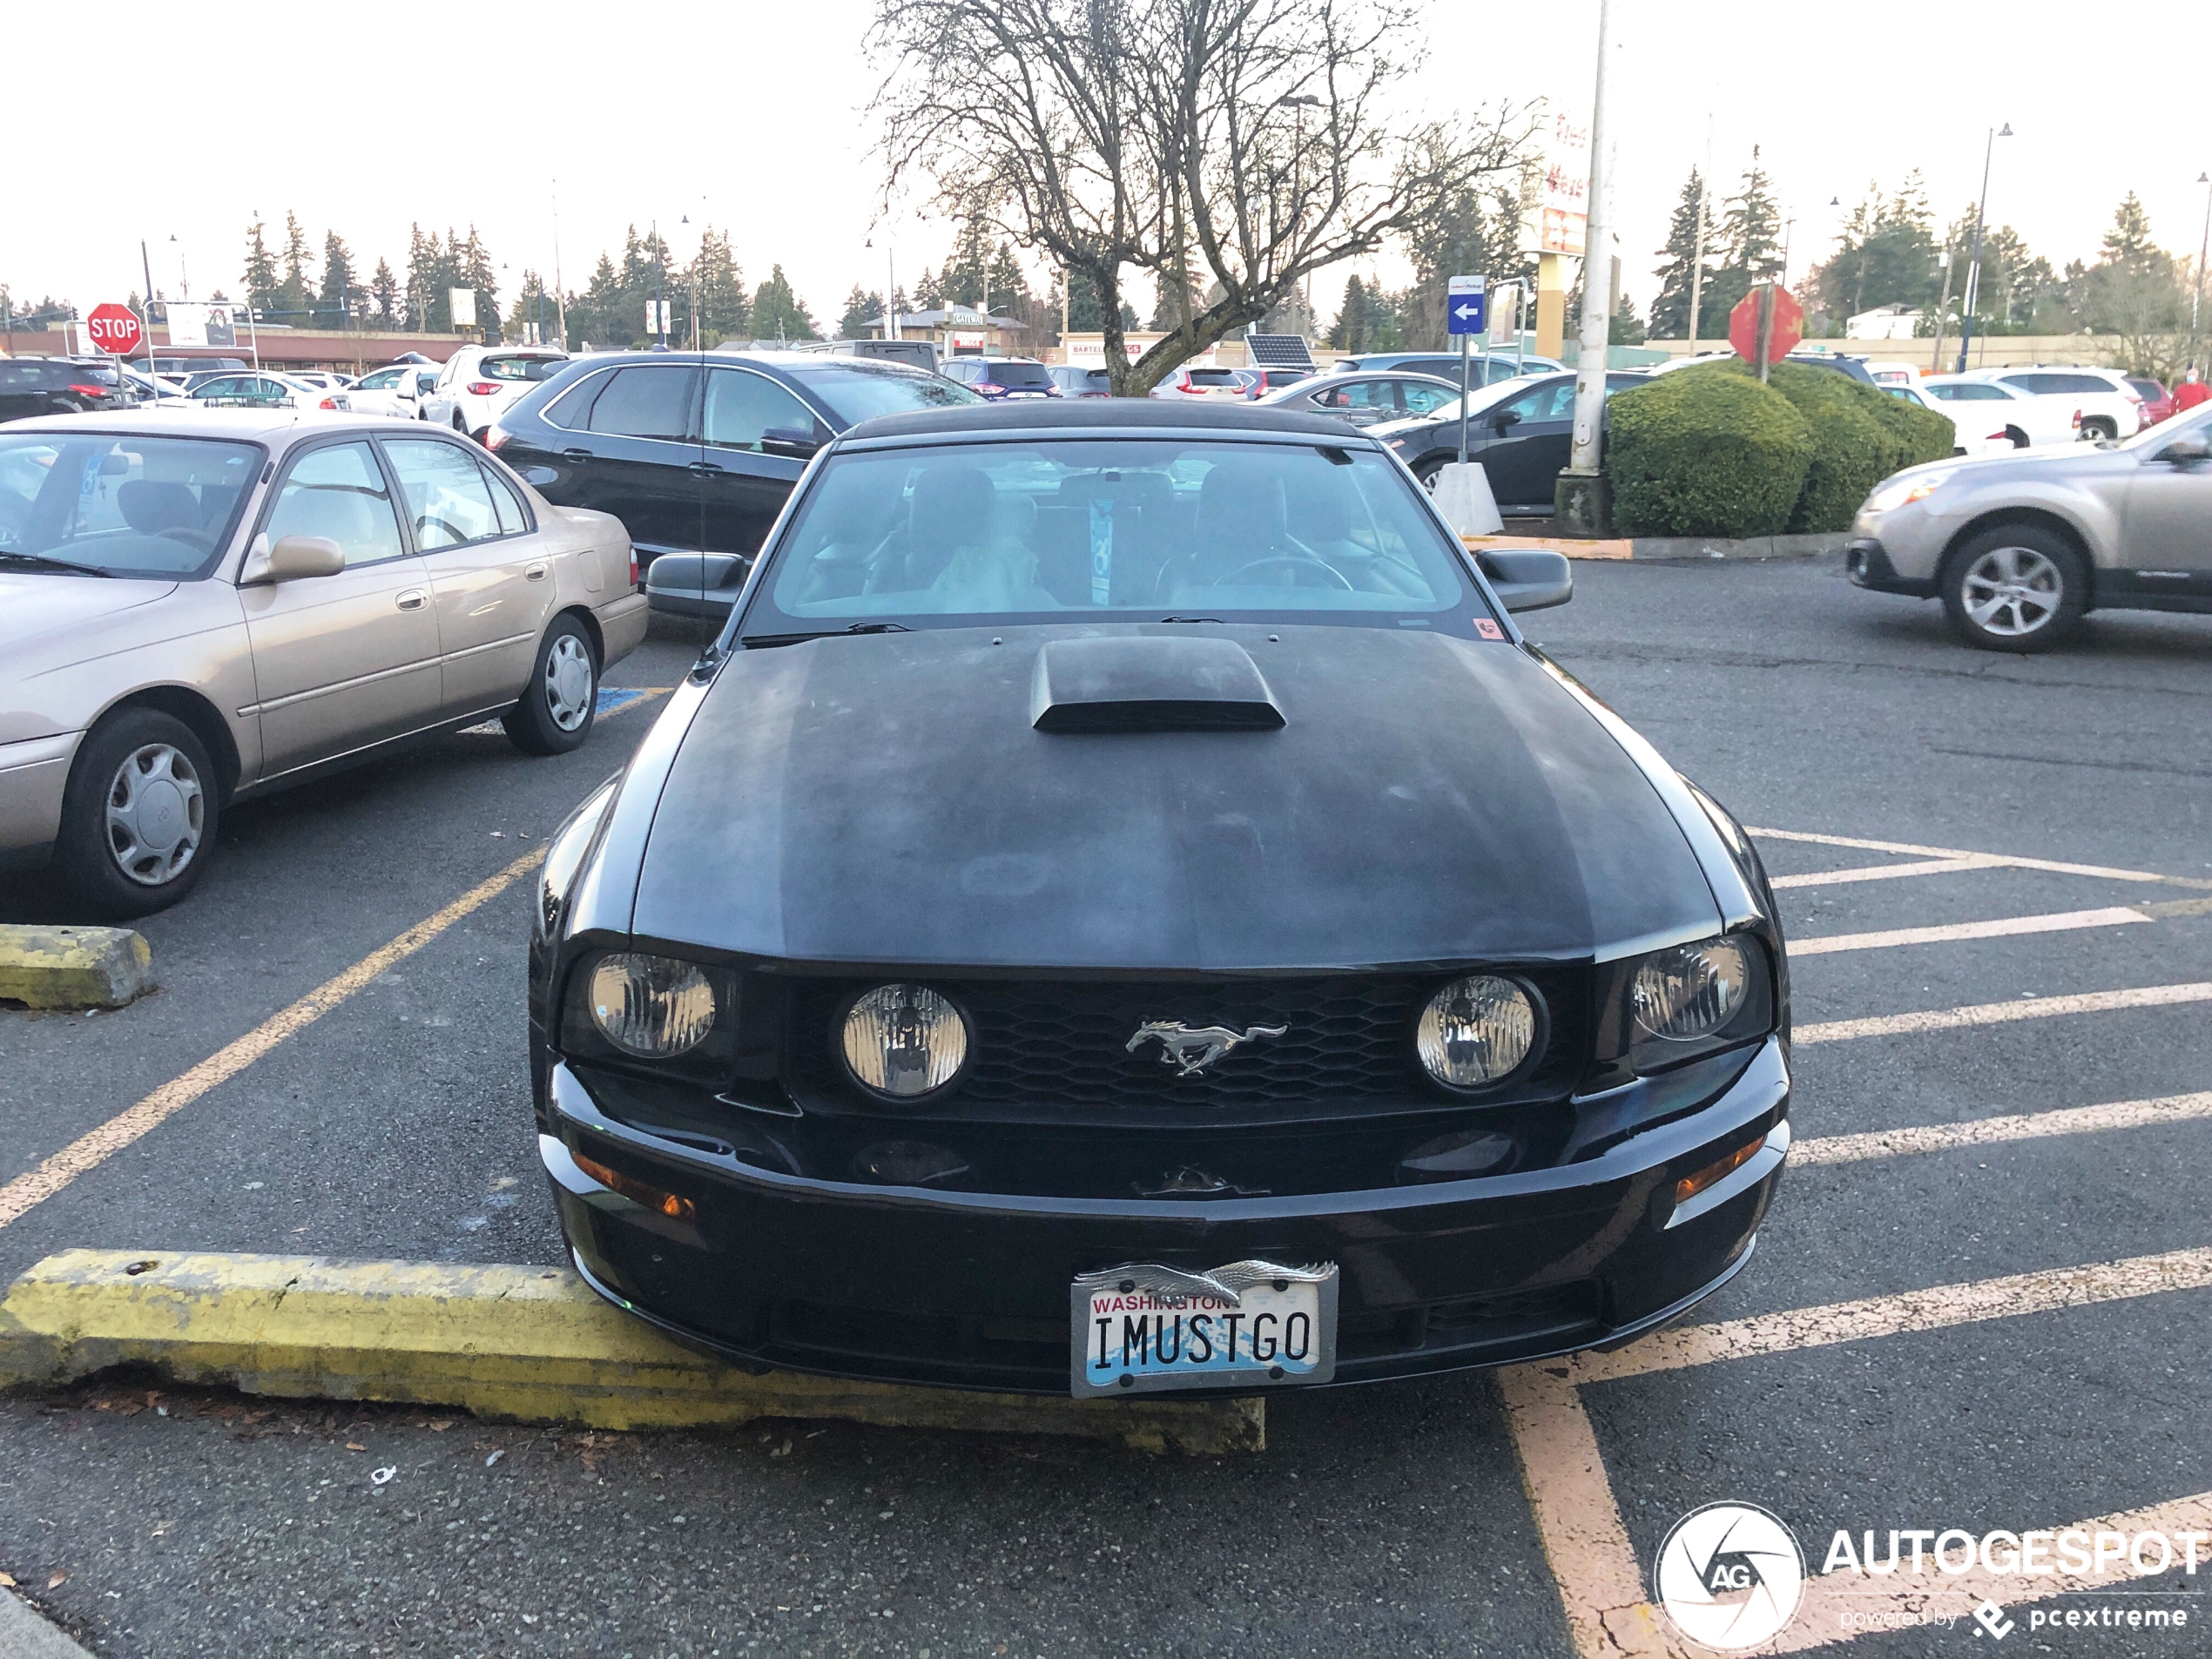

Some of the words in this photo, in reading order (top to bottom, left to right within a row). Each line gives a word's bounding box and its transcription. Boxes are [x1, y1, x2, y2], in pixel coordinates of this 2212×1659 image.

[91, 318, 137, 338] STOP
[955, 314, 983, 323] GATEWAY
[1095, 1312, 1311, 1370] IMUSTGO
